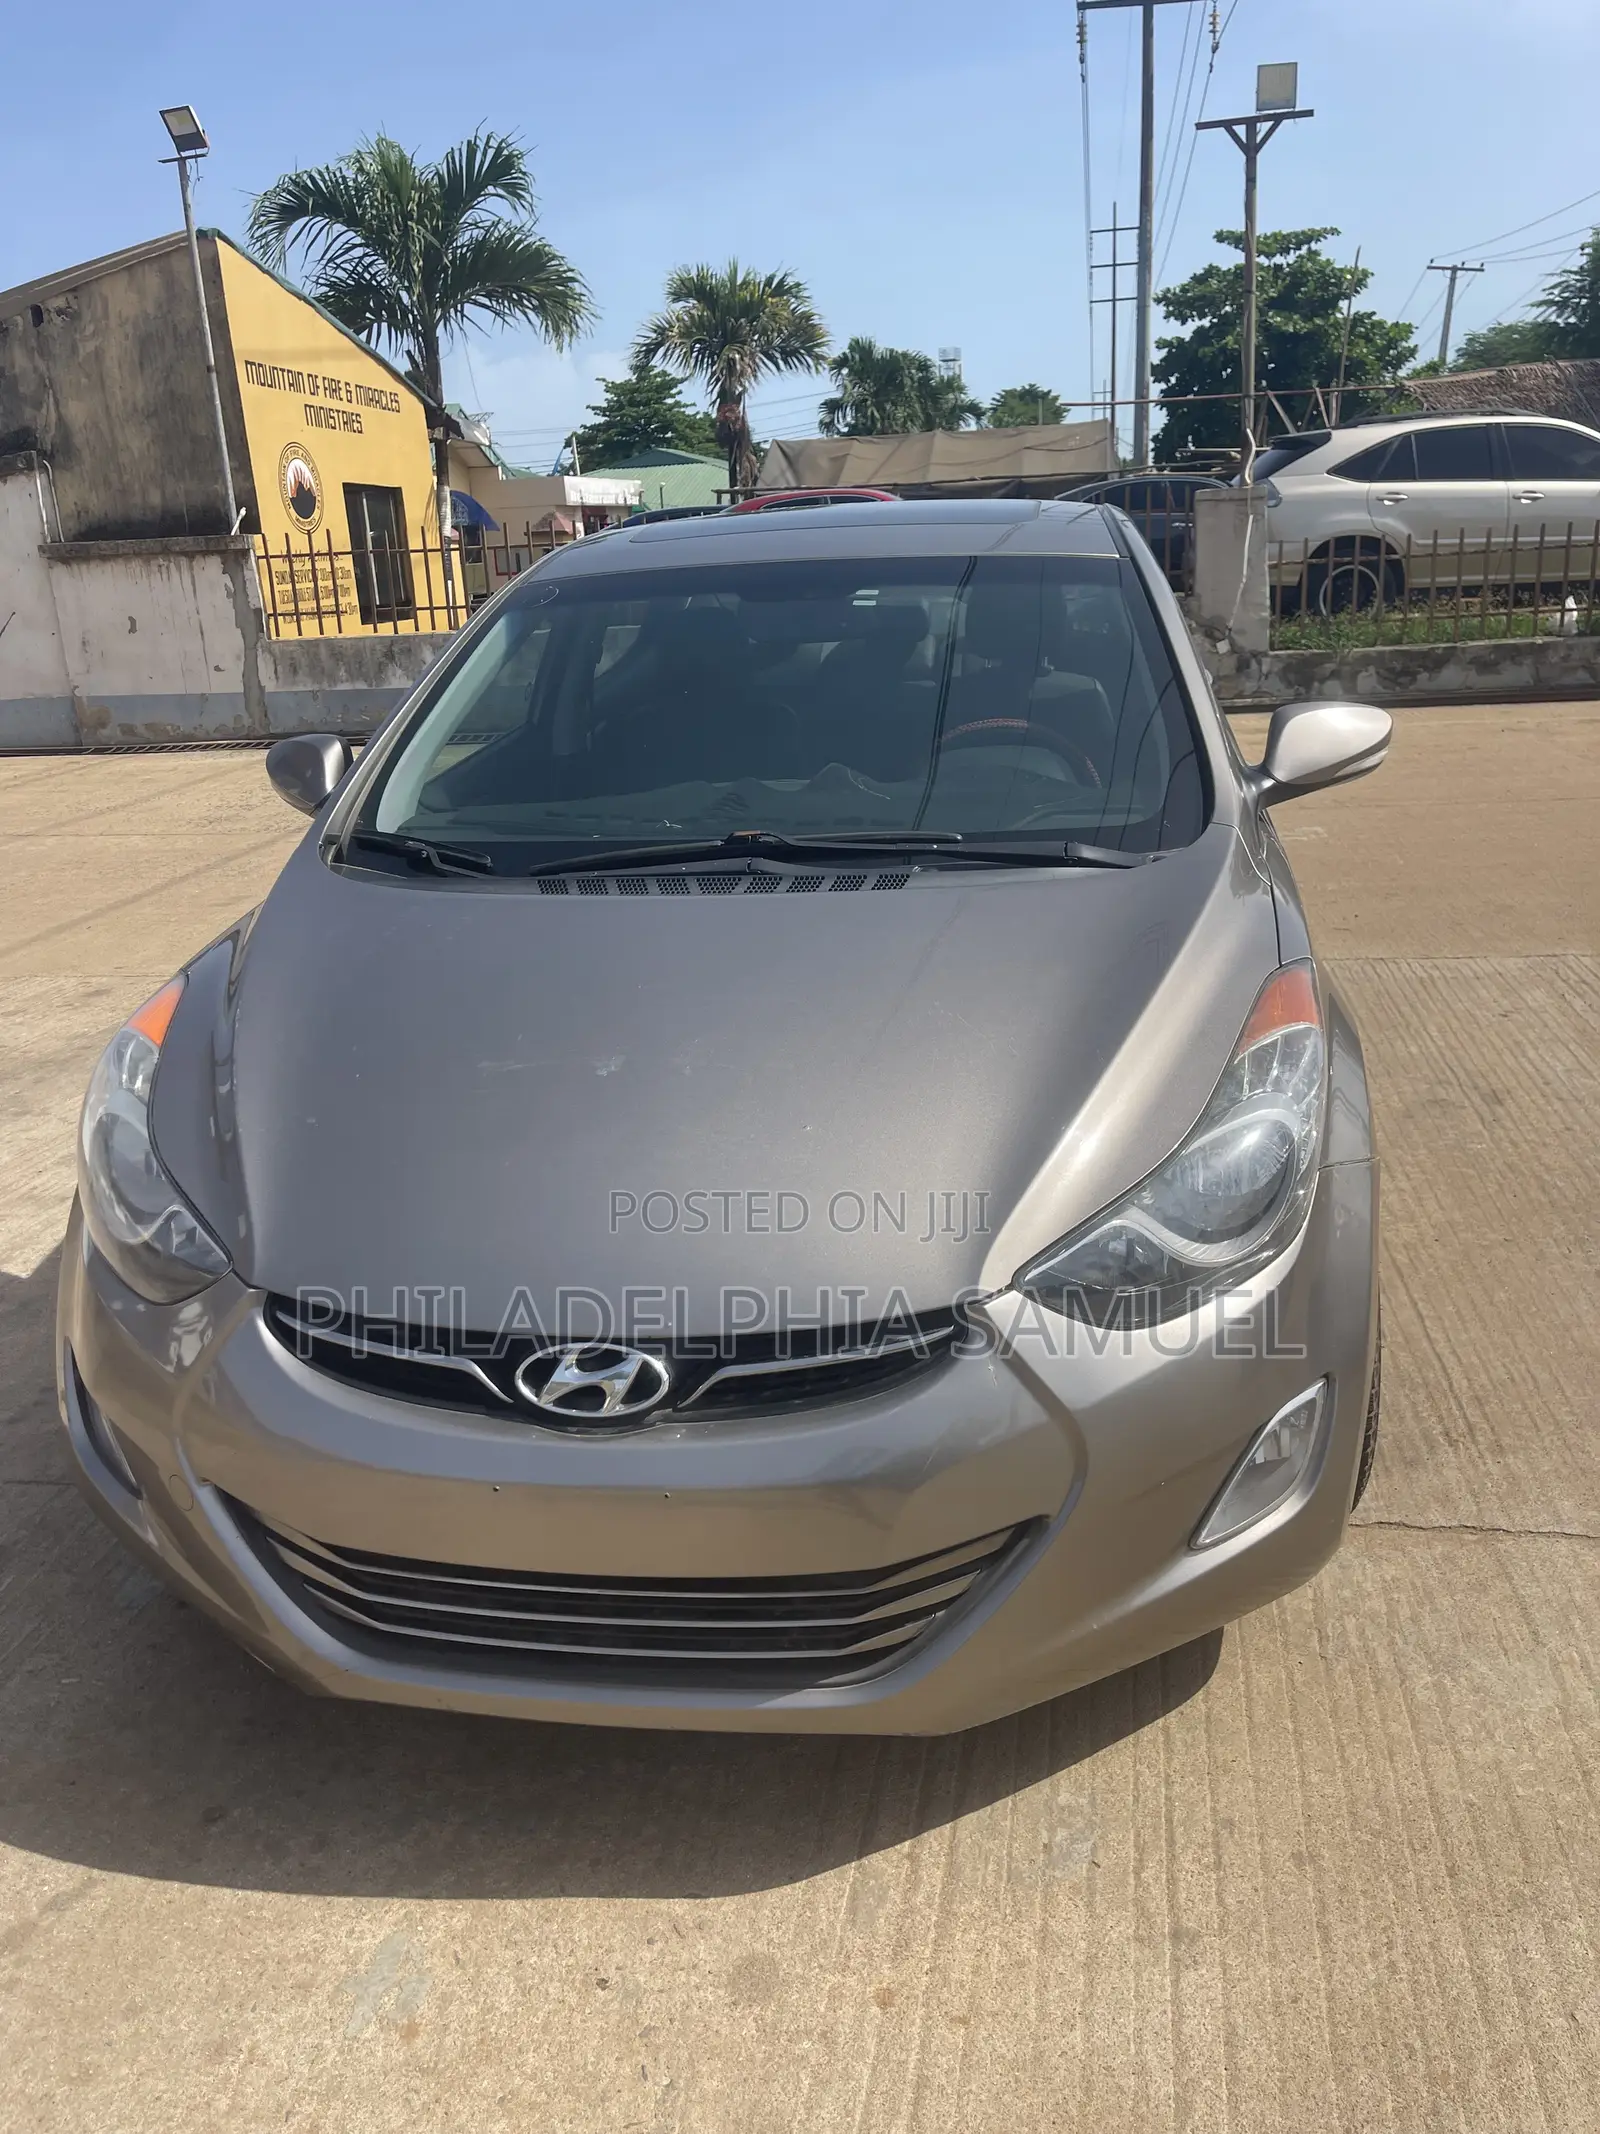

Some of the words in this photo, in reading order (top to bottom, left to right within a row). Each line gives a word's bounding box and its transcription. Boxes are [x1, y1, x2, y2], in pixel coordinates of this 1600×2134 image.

[244, 360, 306, 394] MOUNTAIN
[307, 373, 320, 396] OF
[322, 376, 343, 401] FIRE
[345, 381, 353, 403] &
[355, 384, 400, 413] MIRACLES
